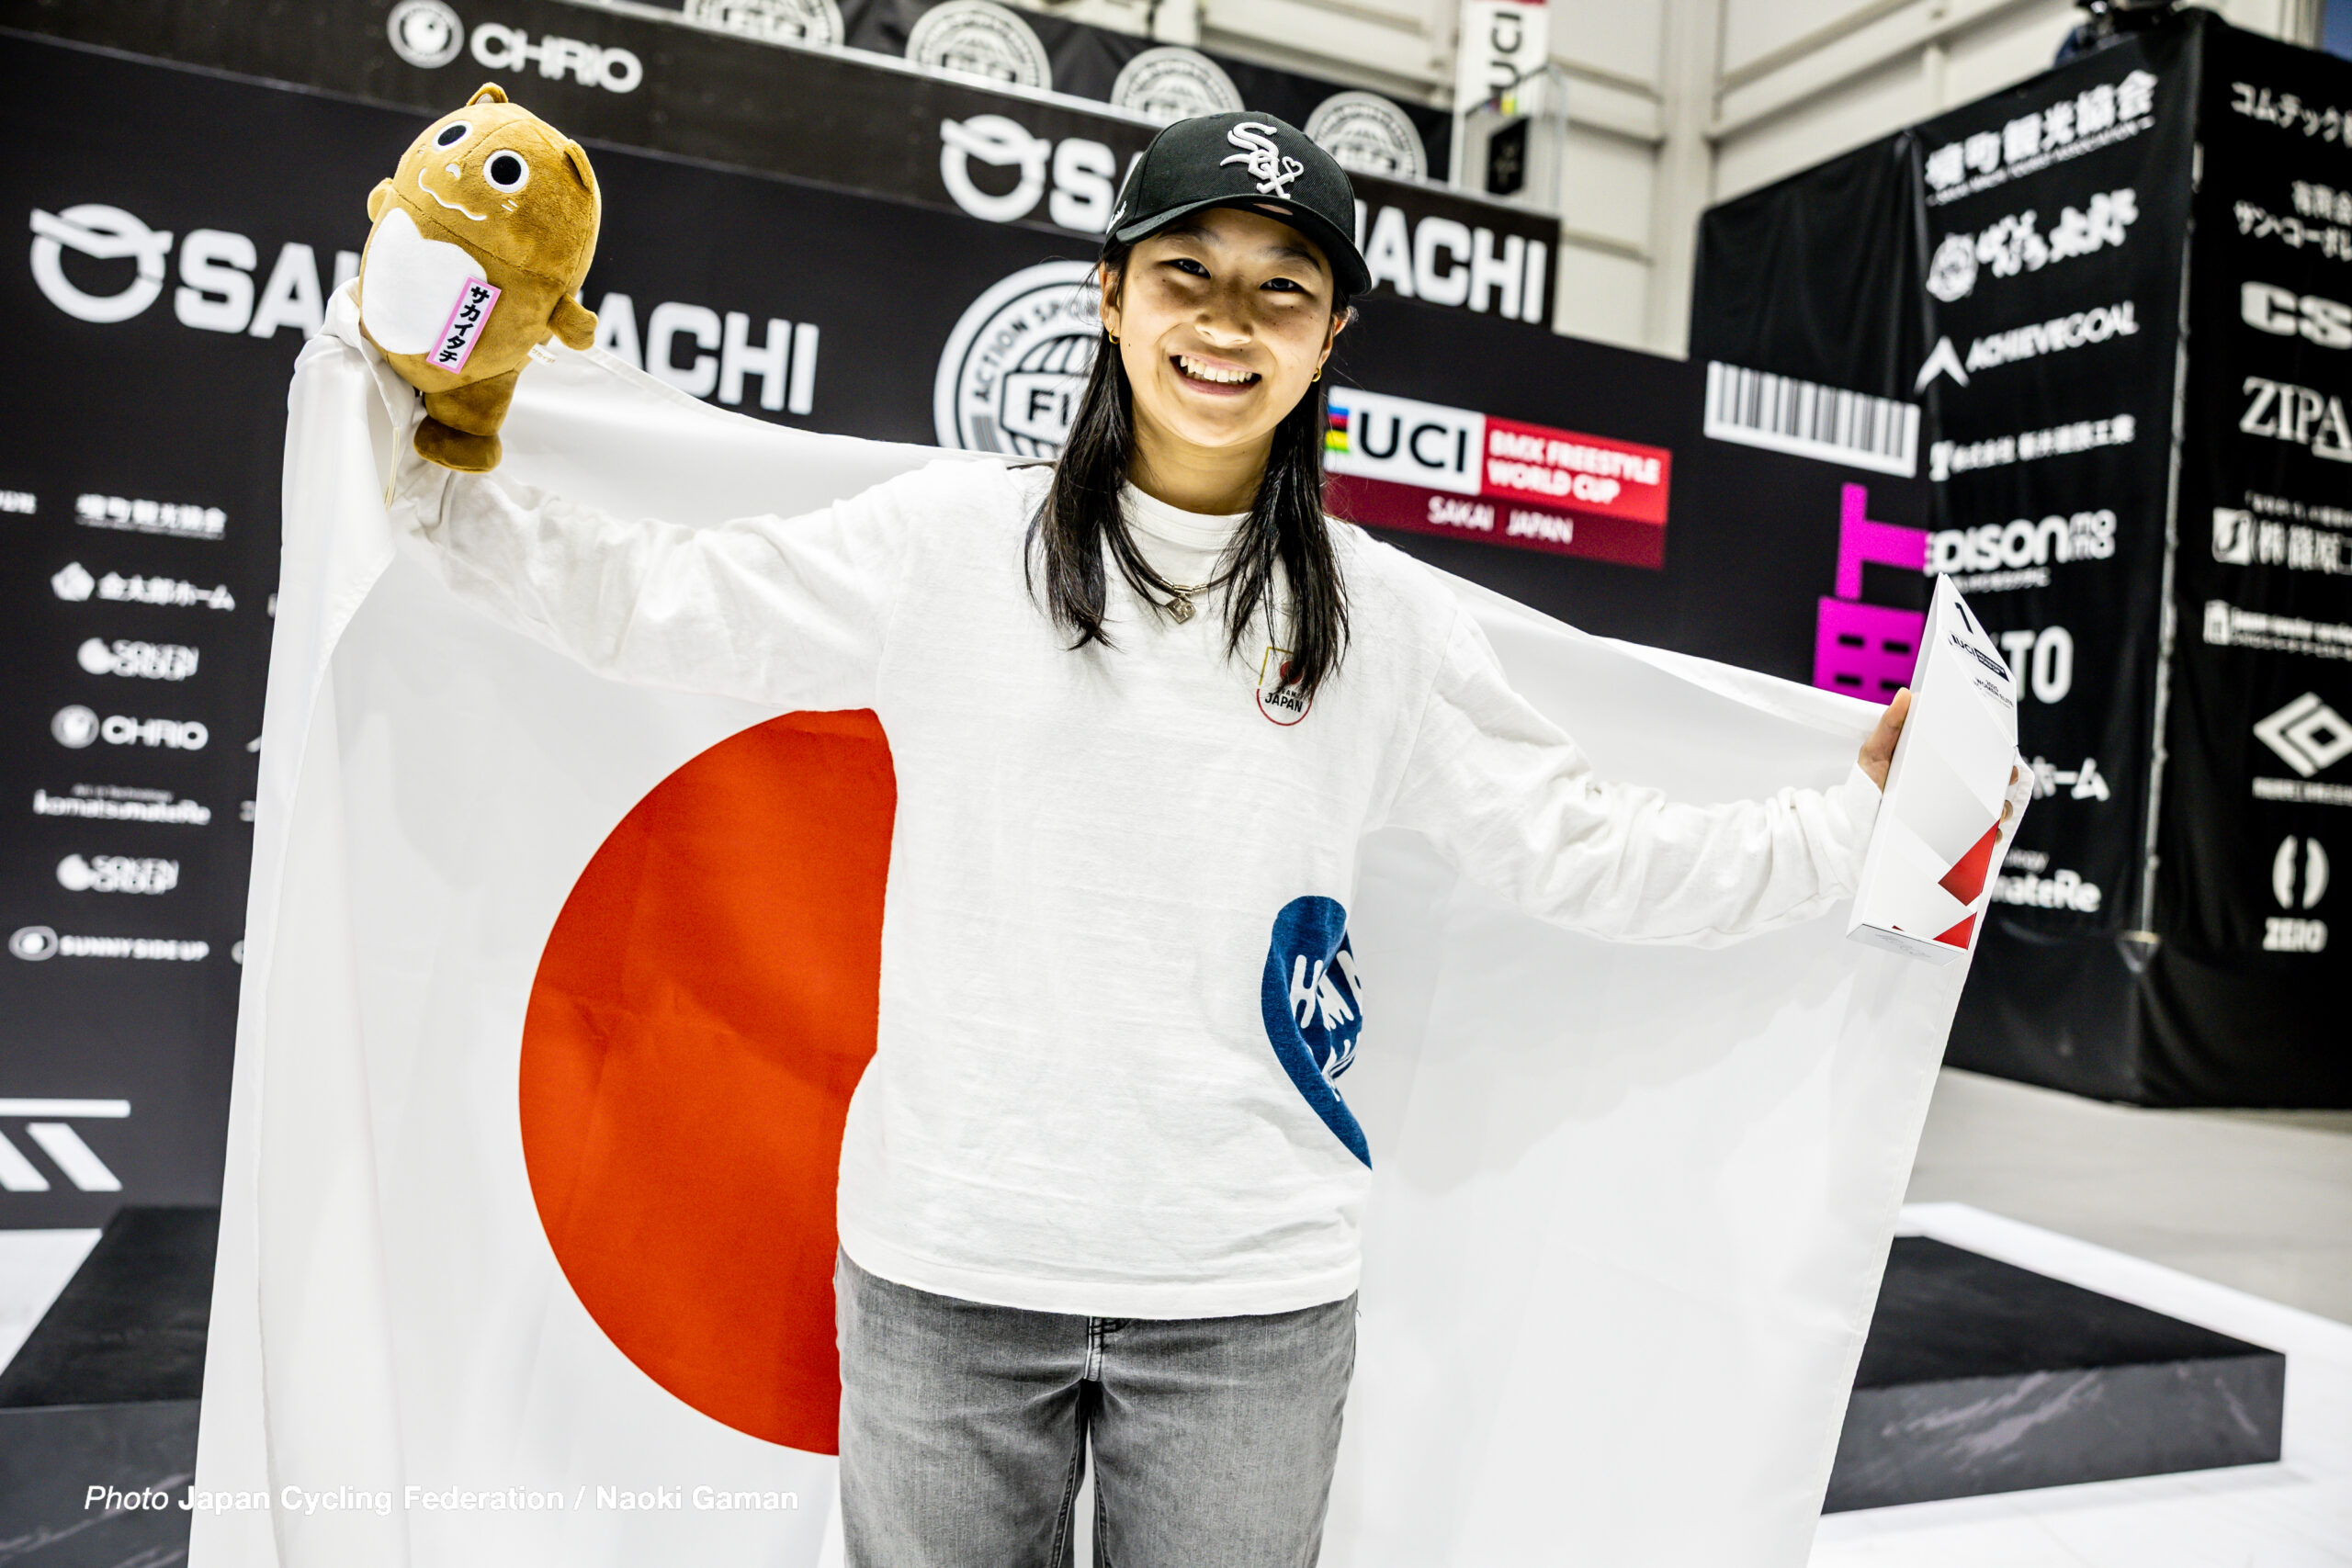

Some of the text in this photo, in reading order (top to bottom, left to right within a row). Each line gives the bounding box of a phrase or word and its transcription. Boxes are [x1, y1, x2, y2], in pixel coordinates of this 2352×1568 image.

[470, 22, 642, 93] CHRIO
[1489, 12, 1523, 94] UCI
[439, 286, 490, 363] サカイタチ
[974, 319, 1028, 404] ACTION
[1359, 412, 1466, 473] UCI
[1547, 440, 1661, 485] FREESTYLE
[1487, 458, 1621, 503] WORLD CUP
[1427, 496, 1574, 545] SAKAI JAPAN
[1954, 602, 1973, 635] 1
[1265, 693, 1303, 713] JAPAN
